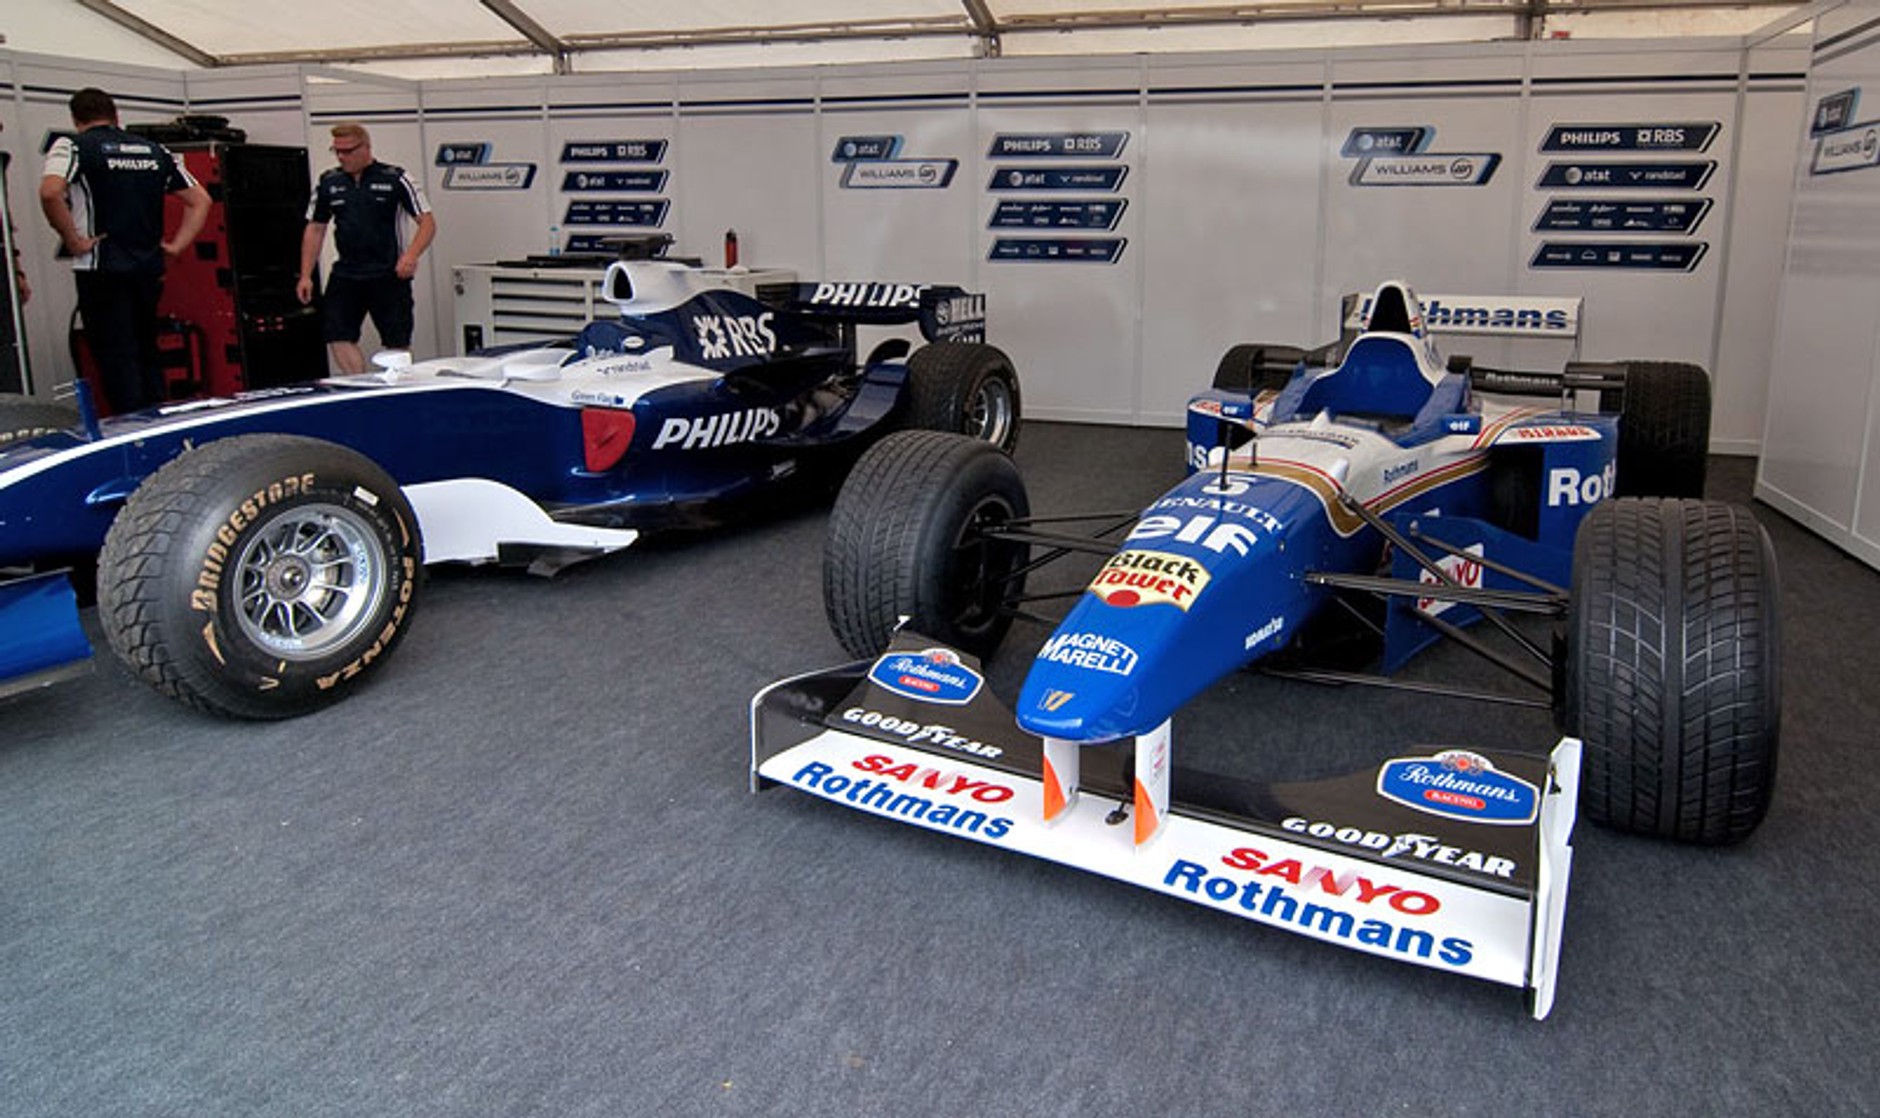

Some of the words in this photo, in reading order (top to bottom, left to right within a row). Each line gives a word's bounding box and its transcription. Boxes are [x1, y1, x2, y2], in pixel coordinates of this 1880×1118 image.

[1003, 139, 1051, 151] PHILIPS
[1560, 131, 1621, 145] PHILIPS
[1654, 129, 1685, 143] RBS
[108, 158, 159, 170] PHILIPS
[1375, 164, 1446, 175] WILLIAMS
[811, 283, 932, 308] PHILIPS
[723, 311, 777, 356] RBS
[651, 407, 781, 450] PHILIPS
[1449, 420, 1471, 432] elf
[1201, 475, 1257, 496] 5
[190, 473, 315, 611] BRIDGESTONE
[1125, 514, 1259, 557] elf
[1094, 567, 1193, 601] Tower
[1109, 553, 1200, 585] Black
[889, 658, 969, 689] Rothmans
[852, 754, 1015, 803] SANYO
[1398, 763, 1521, 803] Rothmans
[792, 761, 1015, 839] Rothmans
[1221, 847, 1441, 917] SANYO
[1163, 859, 1473, 966] Rothmans
